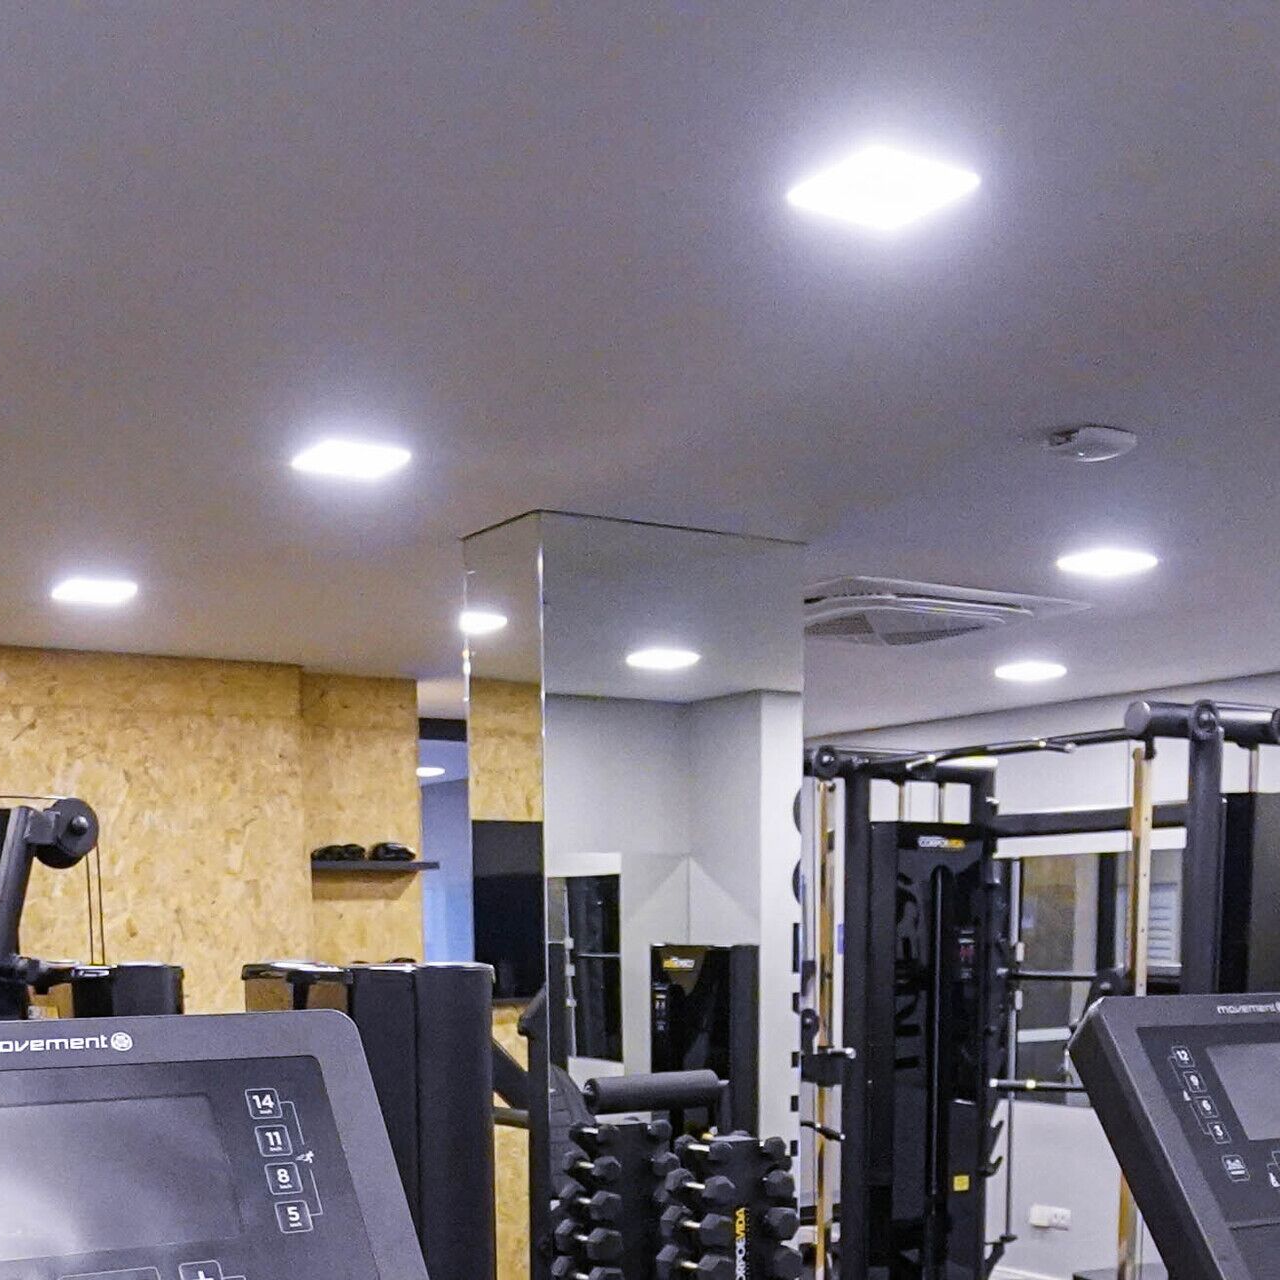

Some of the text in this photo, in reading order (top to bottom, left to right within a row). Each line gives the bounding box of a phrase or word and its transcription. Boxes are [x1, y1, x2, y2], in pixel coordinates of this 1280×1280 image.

[1177, 1050, 1189, 1061] 12
[252, 1094, 274, 1109] 14
[265, 1131, 282, 1146] 11
[277, 1168, 290, 1183] 8
[287, 1206, 300, 1221] 5
